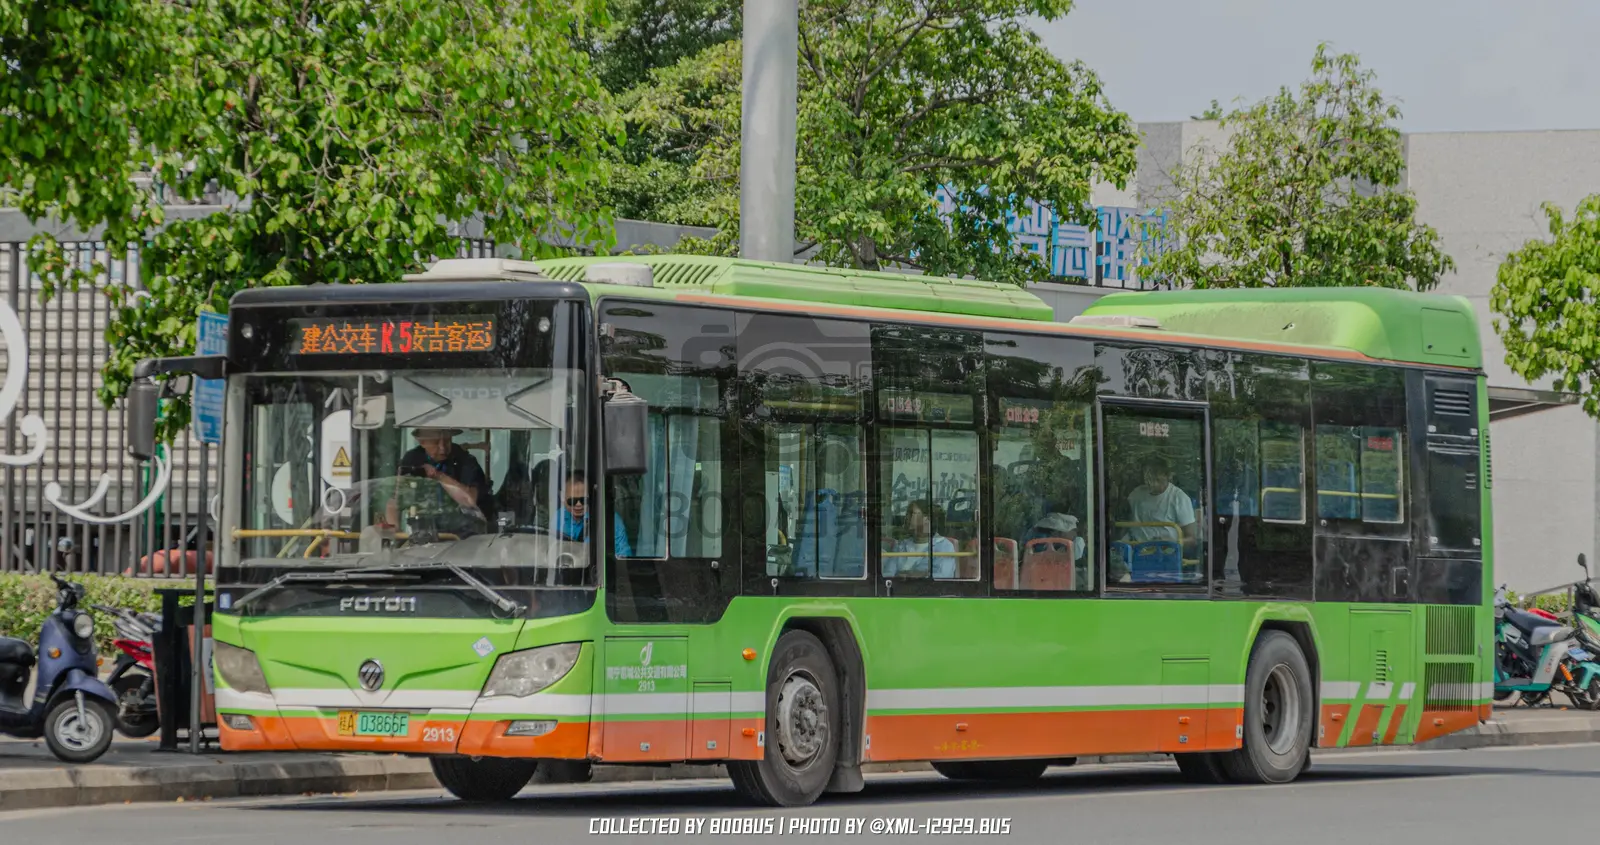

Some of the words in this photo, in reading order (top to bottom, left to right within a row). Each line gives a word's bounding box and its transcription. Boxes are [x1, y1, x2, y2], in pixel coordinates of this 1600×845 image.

[340, 597, 416, 612] FOTON
[638, 681, 655, 692] 2913
[361, 714, 407, 732] 03866F
[423, 727, 455, 742] 2913
